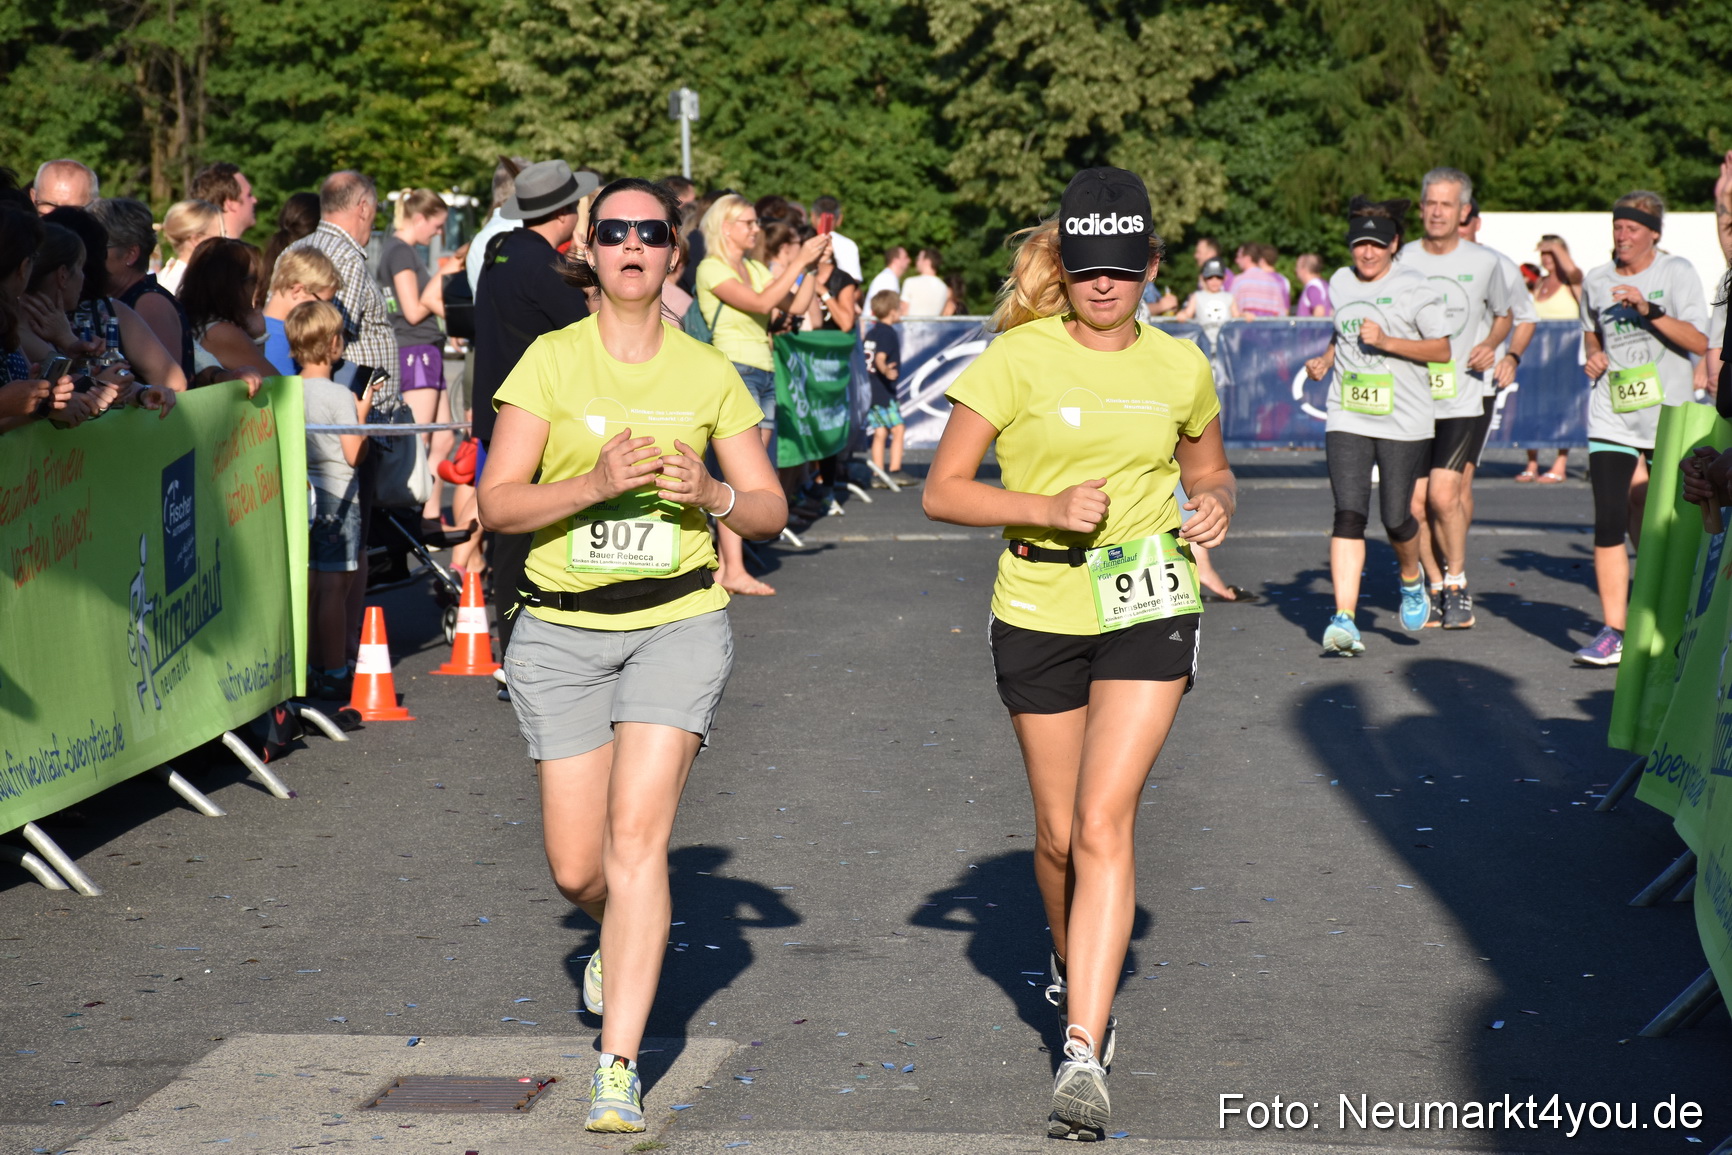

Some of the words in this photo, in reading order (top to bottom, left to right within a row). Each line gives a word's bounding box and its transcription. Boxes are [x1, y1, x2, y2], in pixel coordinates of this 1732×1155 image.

[1065, 211, 1145, 237] adidas
[1351, 386, 1379, 402] 841
[1617, 381, 1648, 400] 842
[42, 447, 85, 501] Firmen
[169, 495, 192, 527] Fischer
[590, 520, 654, 551] 907
[590, 551, 614, 560] Bauer
[617, 552, 654, 561] Rebecca
[1103, 553, 1138, 568] firmenlauf
[1115, 562, 1180, 604] 915
[152, 537, 222, 668] firmenlauf
[161, 651, 190, 698] neumarkt
